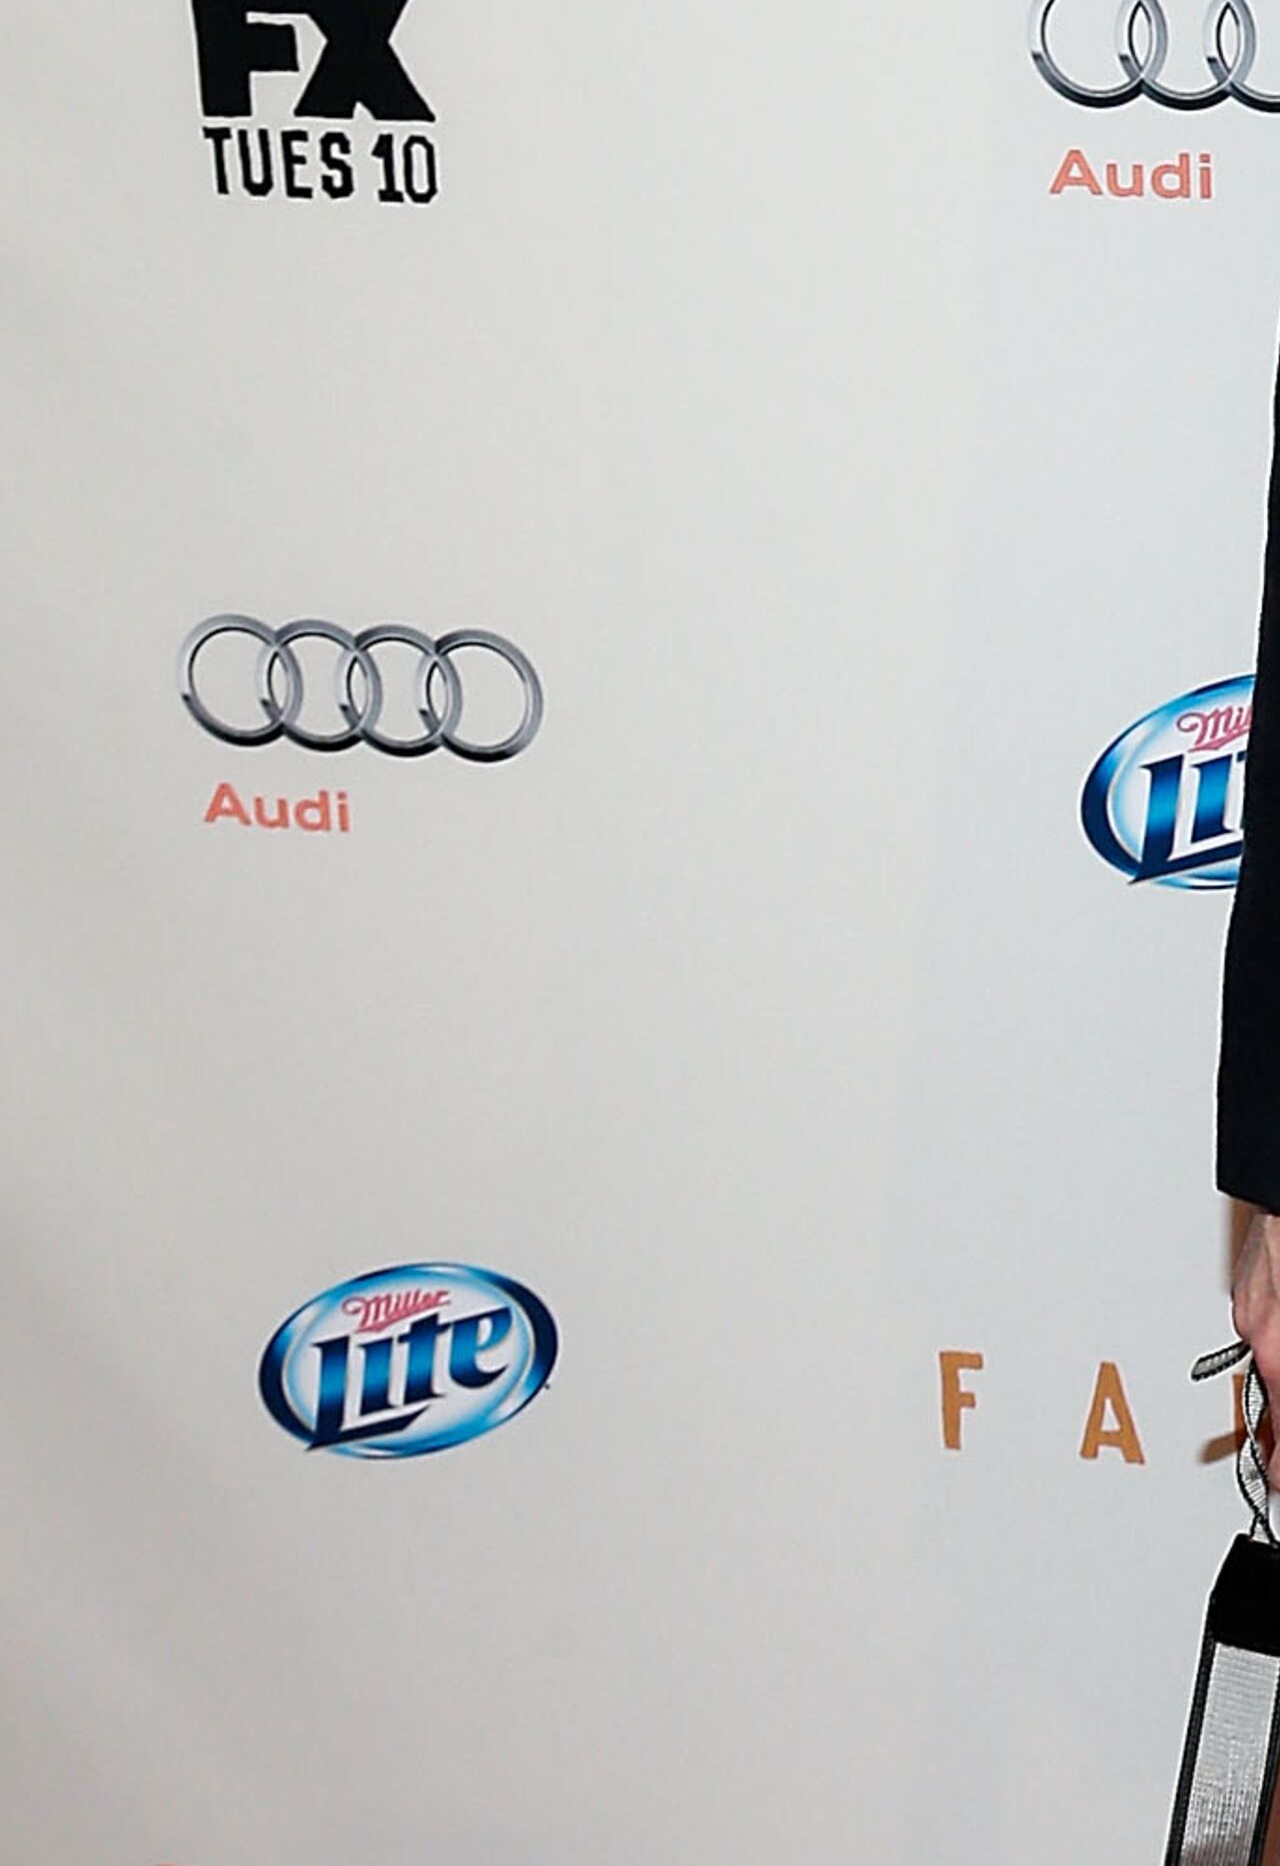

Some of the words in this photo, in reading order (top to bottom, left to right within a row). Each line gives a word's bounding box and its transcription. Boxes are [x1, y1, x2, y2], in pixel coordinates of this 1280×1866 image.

[202, 126, 355, 200] TUES
[371, 125, 438, 204] 10
[1050, 148, 1213, 201] Audi
[204, 781, 352, 834] Audi
[341, 1289, 452, 1334] Miller
[306, 1306, 513, 1451] Lite
